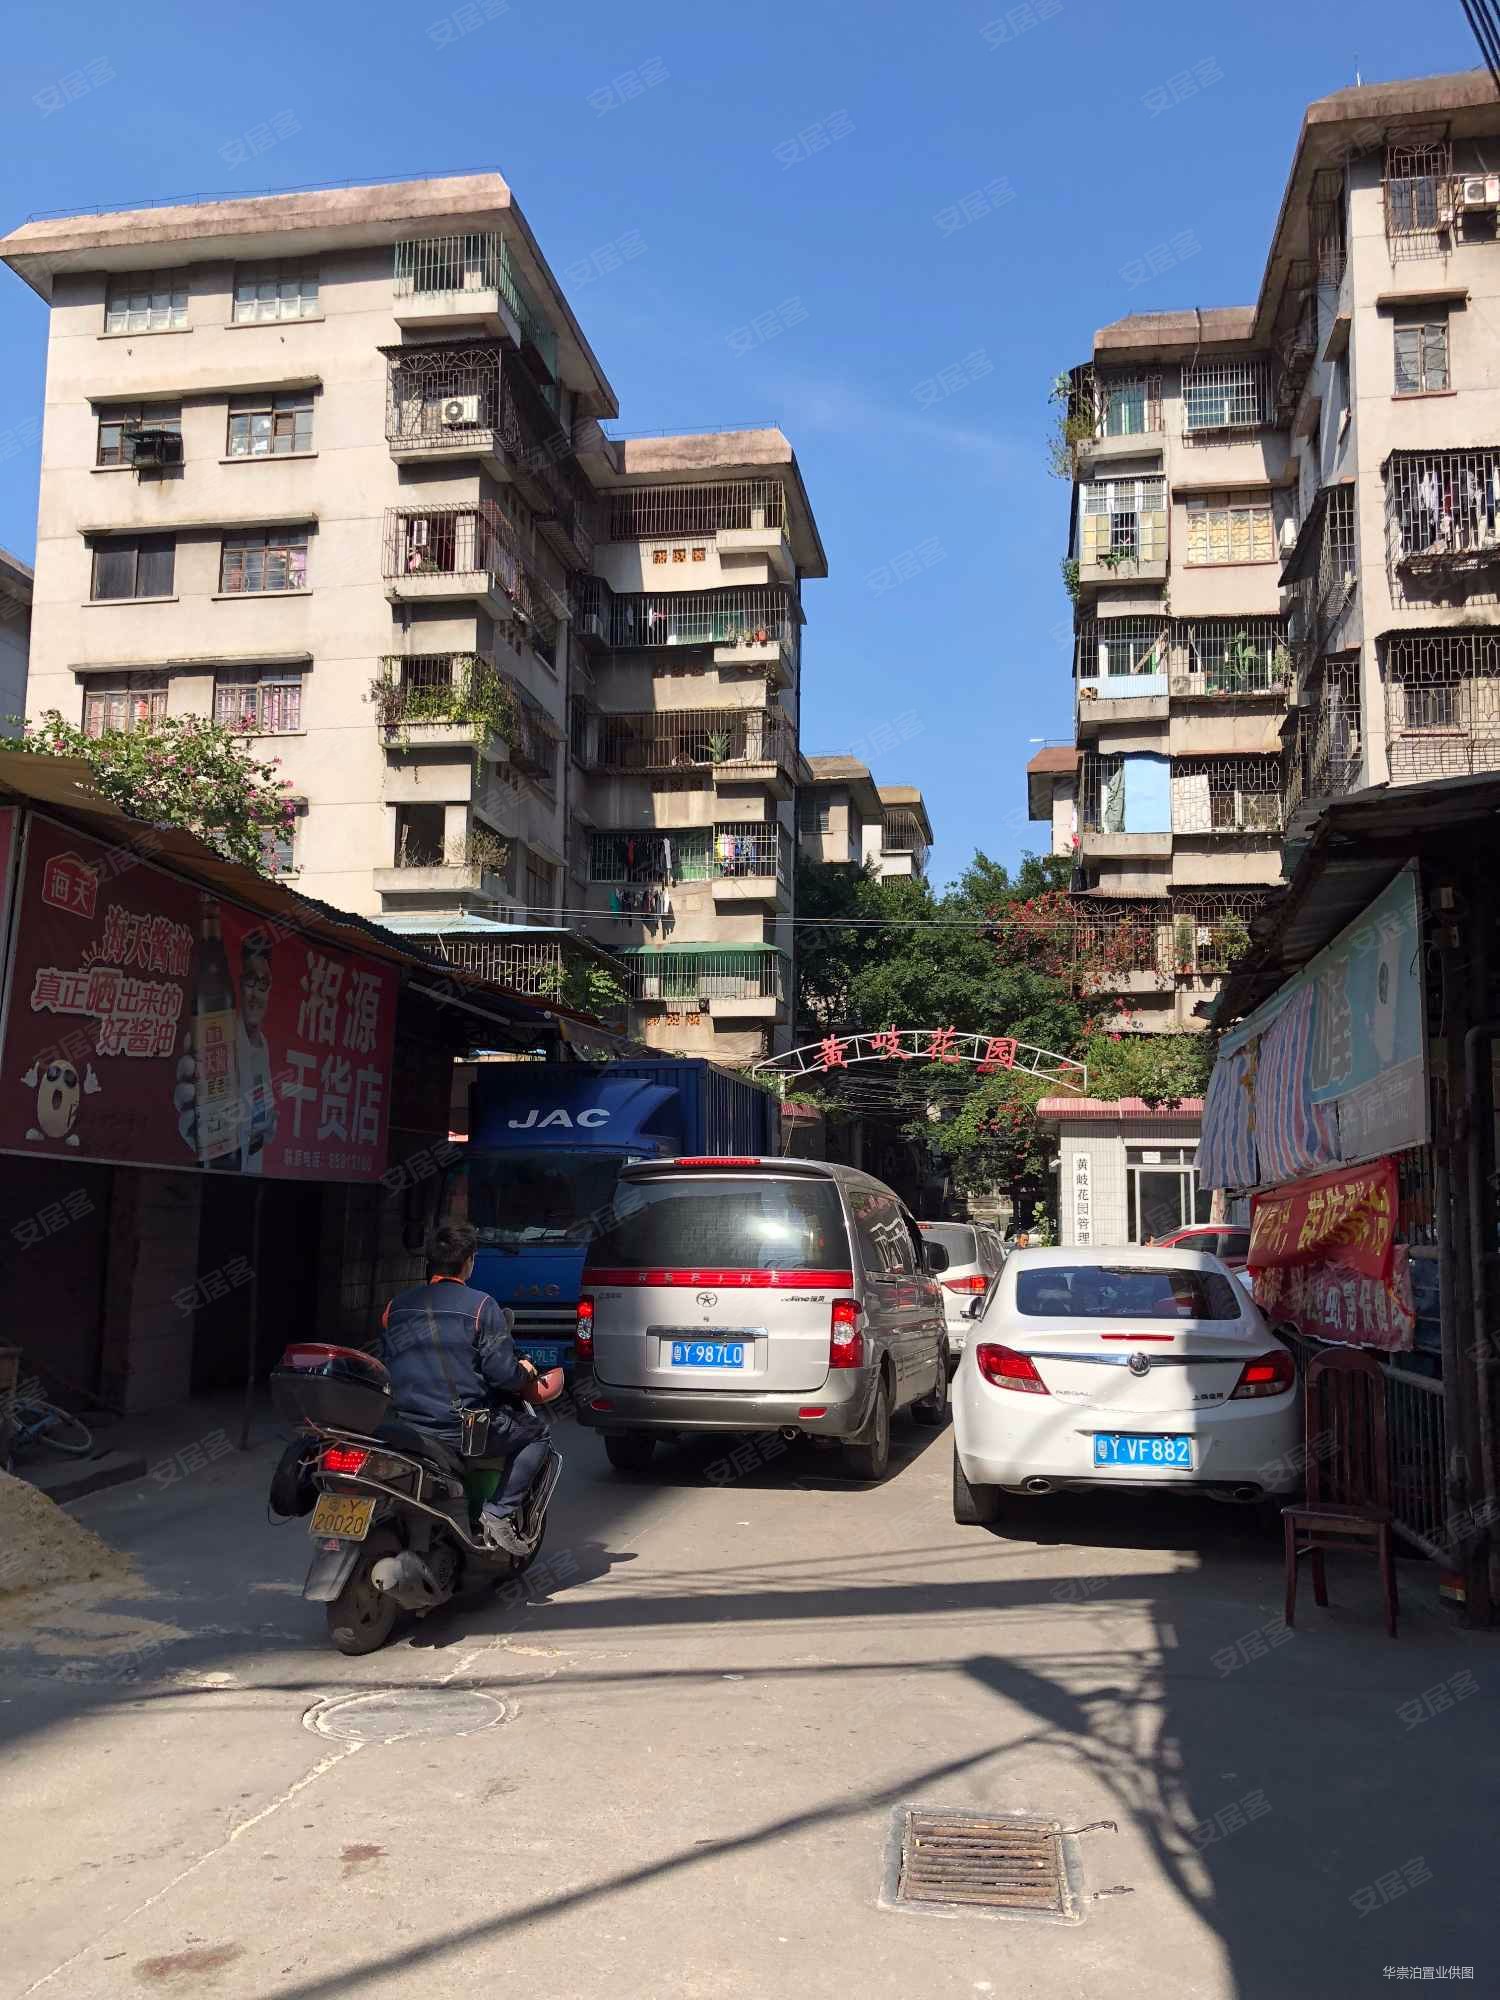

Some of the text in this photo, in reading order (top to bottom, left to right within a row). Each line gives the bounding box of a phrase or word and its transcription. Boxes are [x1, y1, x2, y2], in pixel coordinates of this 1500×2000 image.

[51, 867, 91, 911] 海天
[102, 904, 192, 976] 海天酱油
[33, 968, 183, 1019] 真正晒出来的
[296, 951, 383, 1054] 湘源
[97, 1015, 176, 1056] 好酱油
[814, 1024, 1018, 1072] 黄岐花园
[281, 1048, 383, 1147] 干货店
[508, 1108, 610, 1128] JAC
[1076, 1157, 1090, 1245] 黄岐花园管理
